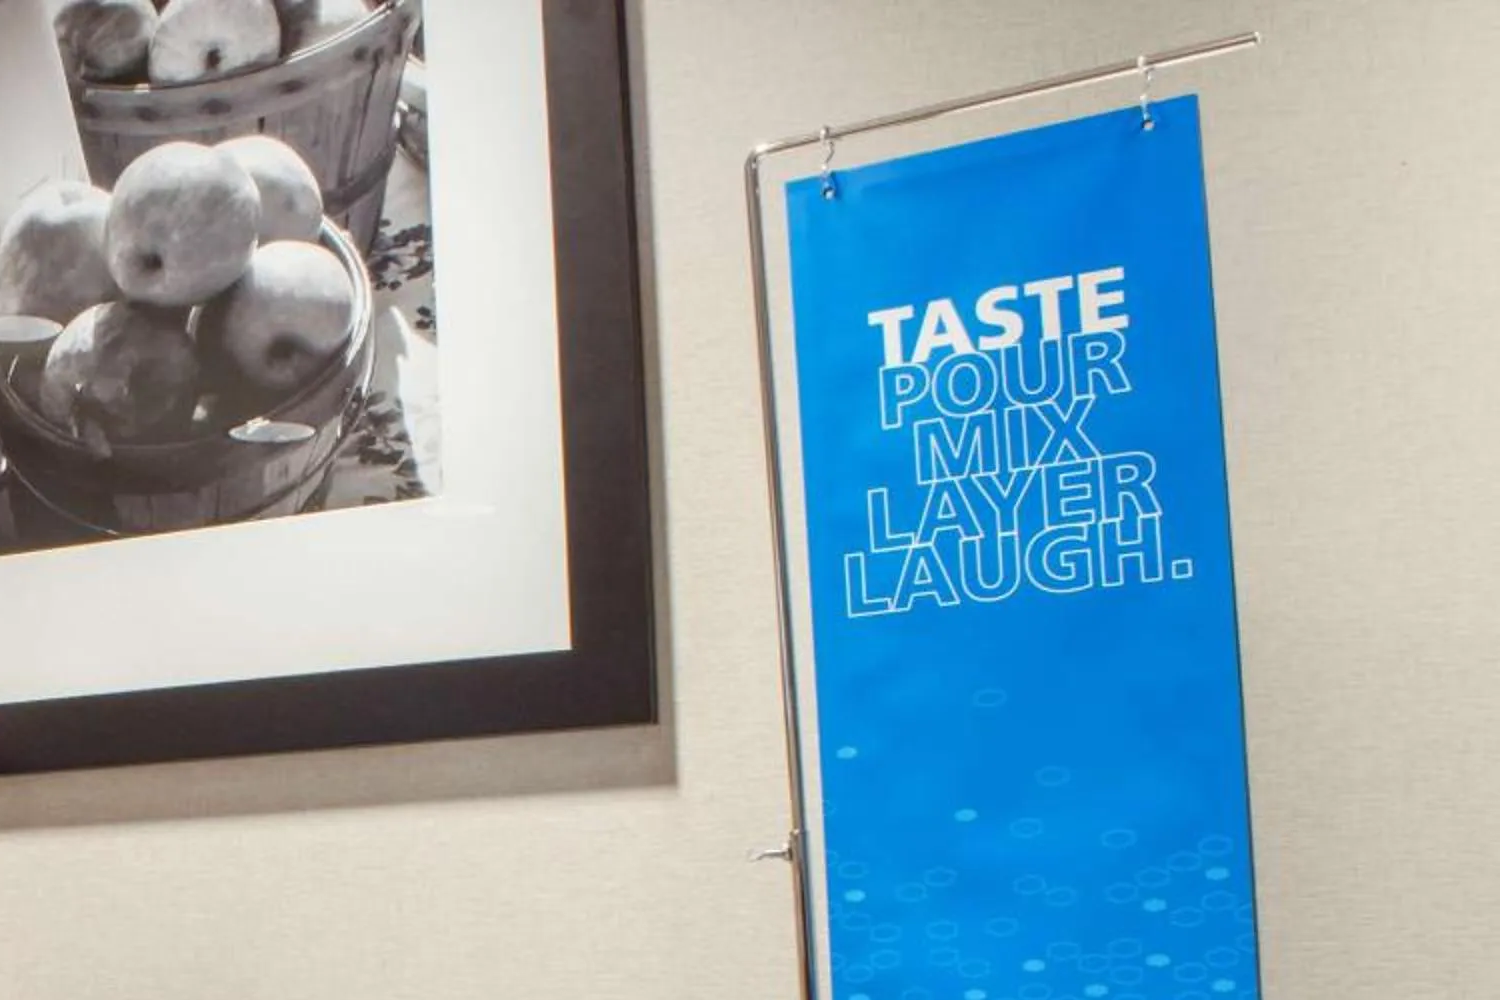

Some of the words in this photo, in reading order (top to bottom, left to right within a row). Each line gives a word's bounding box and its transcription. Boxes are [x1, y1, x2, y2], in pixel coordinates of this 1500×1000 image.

[867, 266, 1129, 365] TASTE
[879, 330, 1132, 430] POUR
[913, 397, 1100, 485] MIX
[867, 452, 1163, 552] LAYER
[844, 512, 1193, 618] LAUGH.
